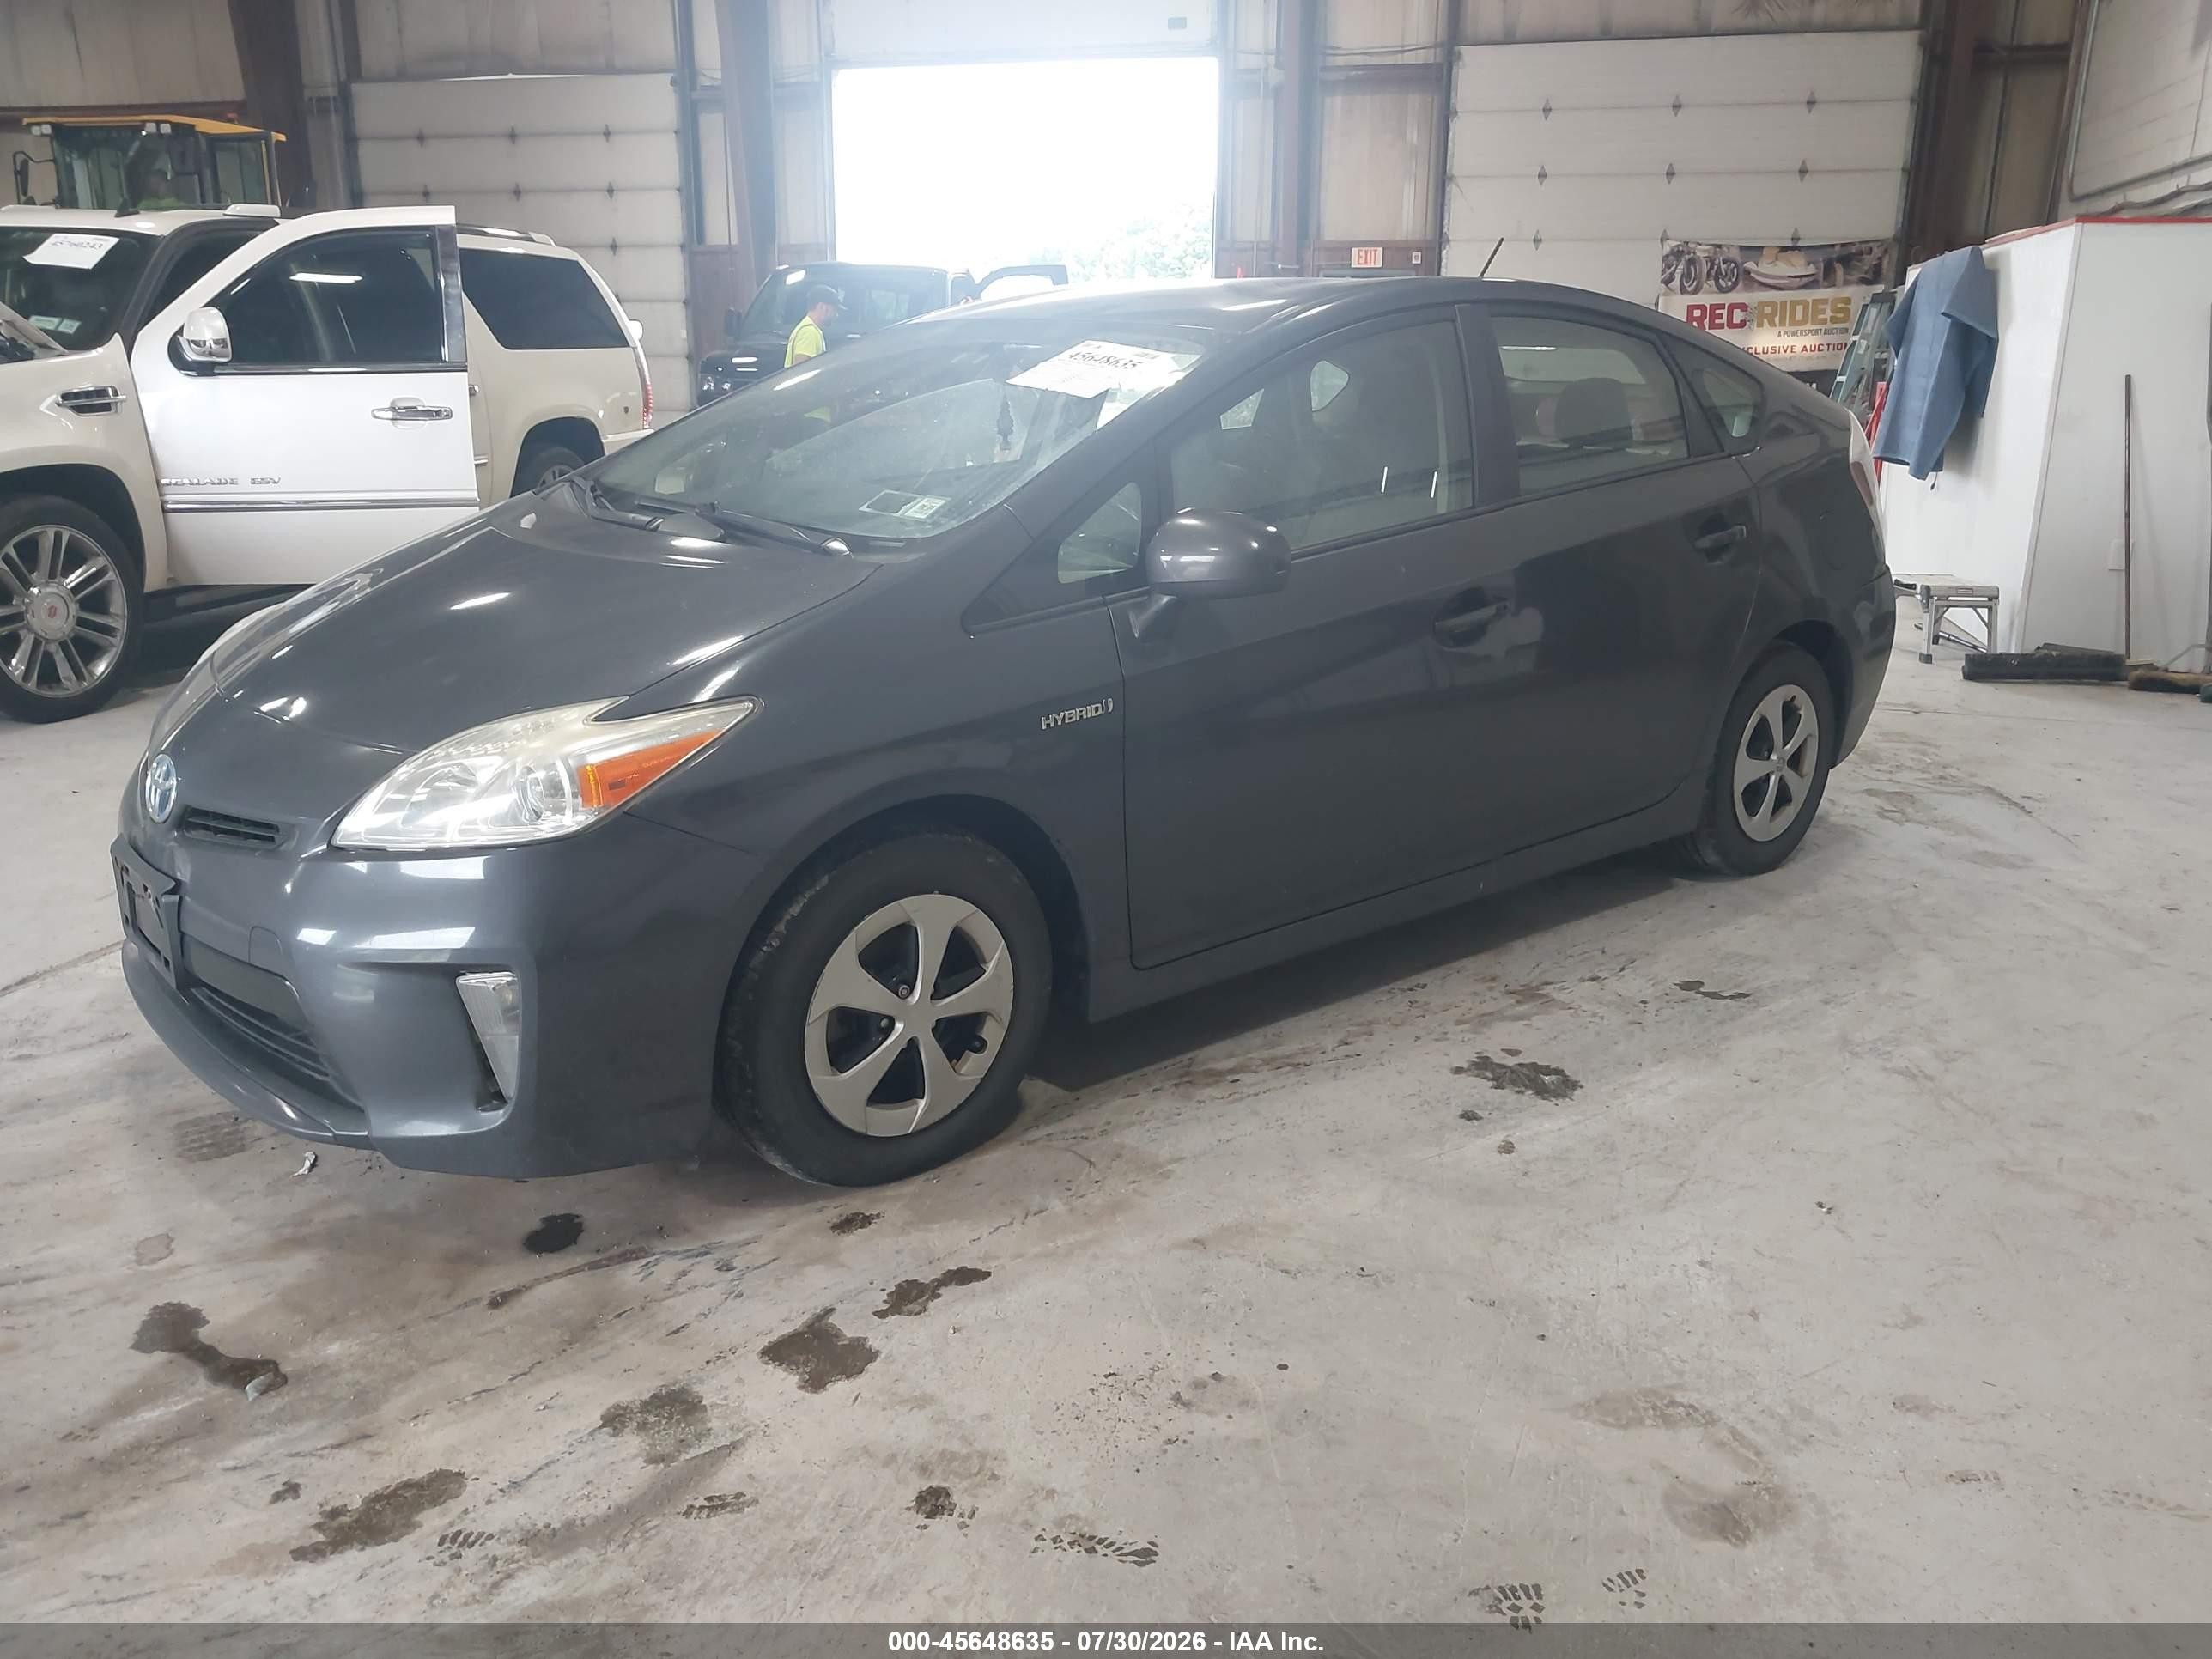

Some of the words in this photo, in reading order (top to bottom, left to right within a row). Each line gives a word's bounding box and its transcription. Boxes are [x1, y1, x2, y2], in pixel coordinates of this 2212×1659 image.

[1357, 248, 1378, 265] EXIT
[1686, 302, 1749, 331] REC
[1756, 296, 1852, 329] RIDES
[1783, 328, 1822, 337] POWERSPORT
[1741, 344, 1797, 356] CLUSIVE
[250, 477, 282, 485] ESV
[1041, 703, 1103, 730] HYBRID
